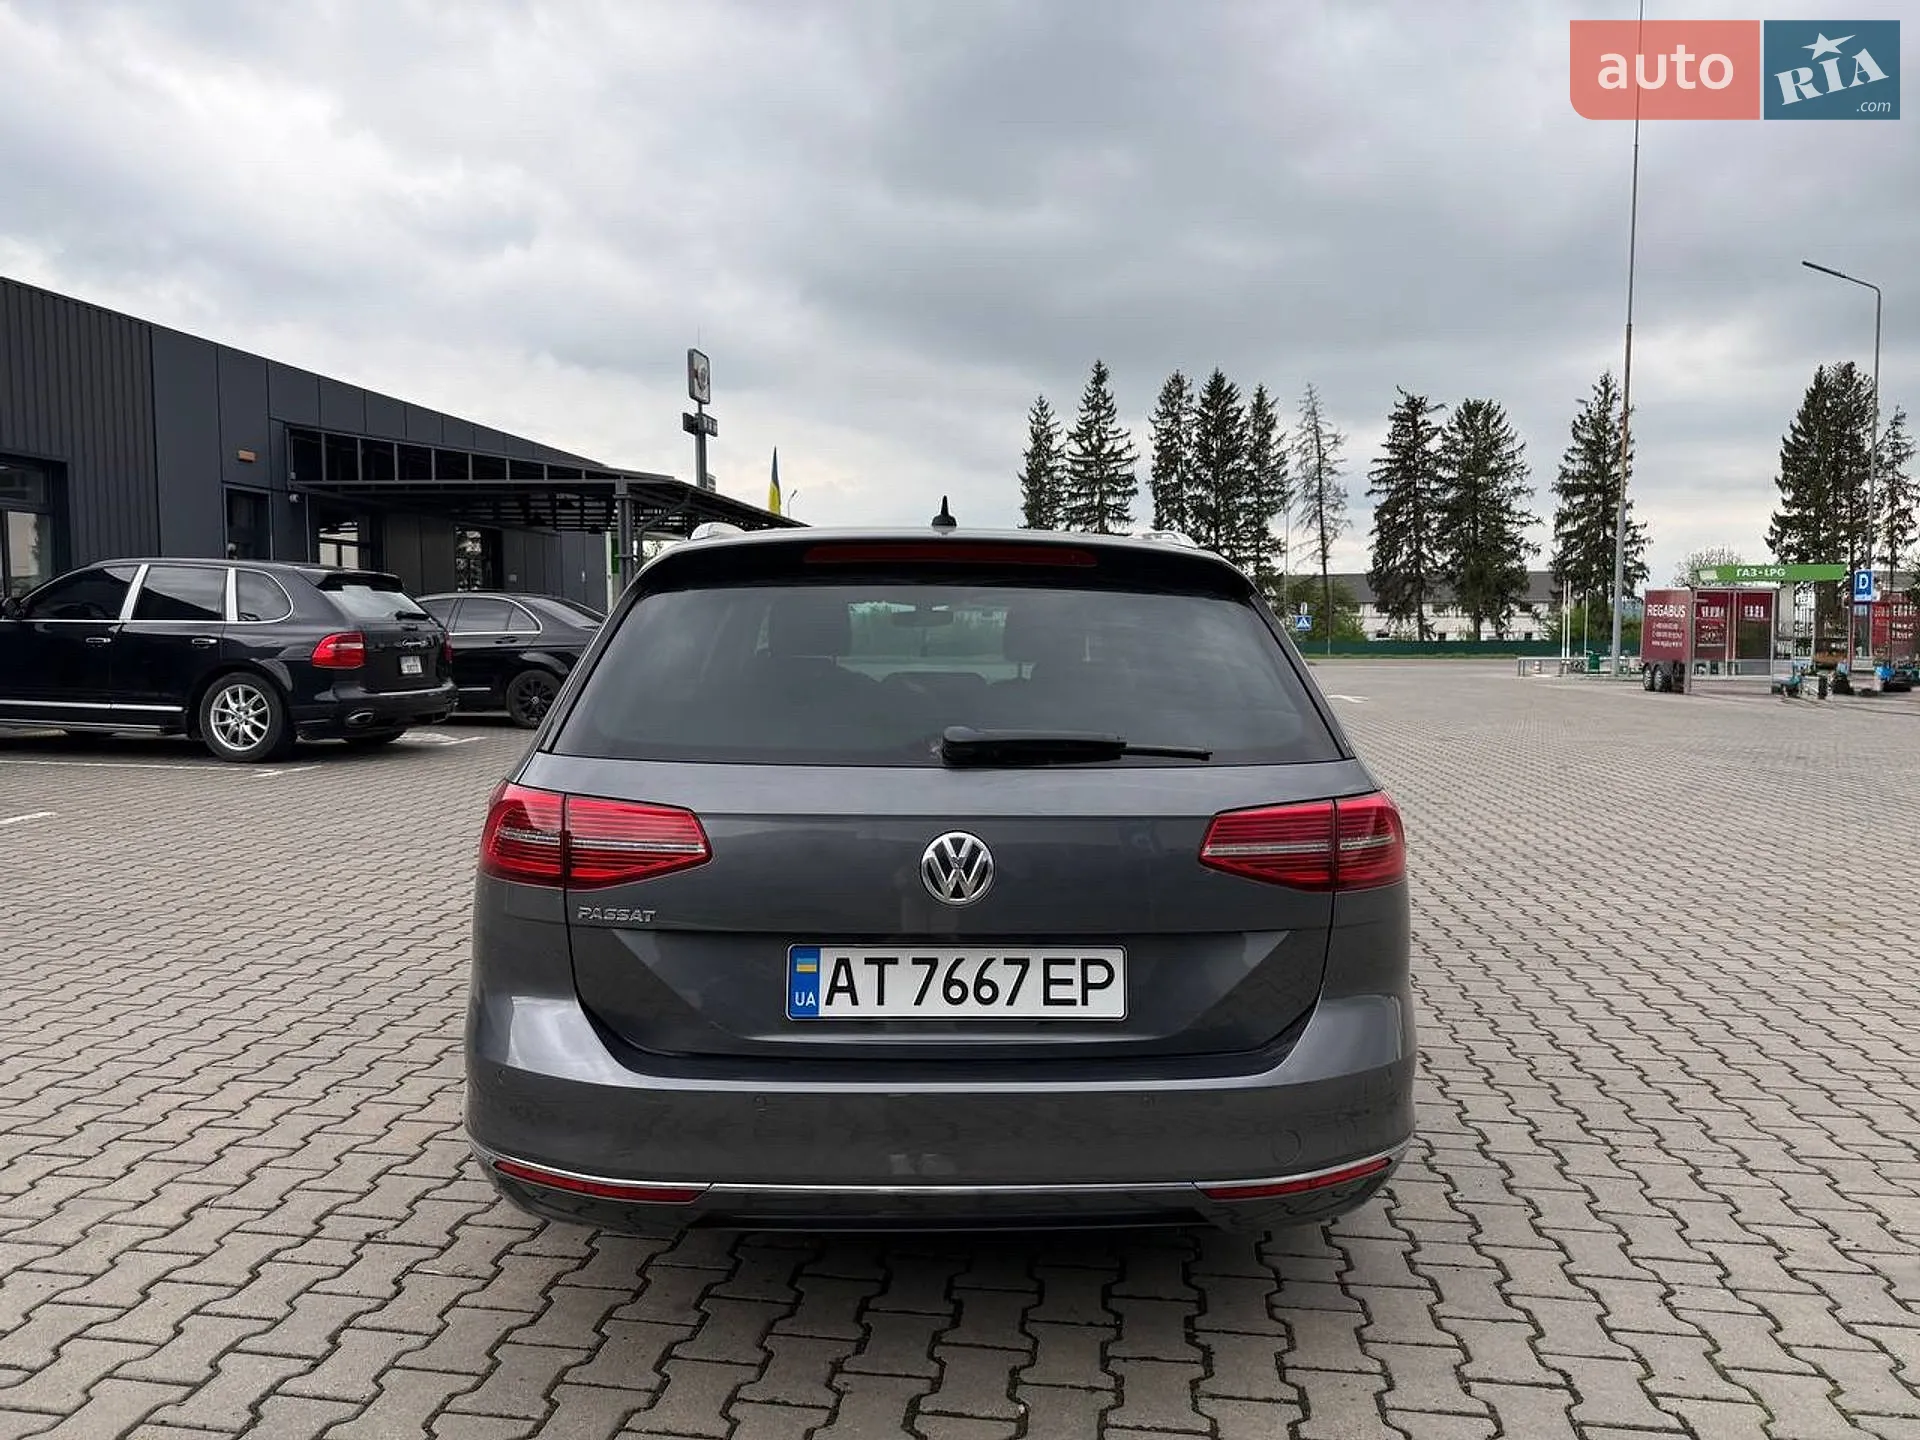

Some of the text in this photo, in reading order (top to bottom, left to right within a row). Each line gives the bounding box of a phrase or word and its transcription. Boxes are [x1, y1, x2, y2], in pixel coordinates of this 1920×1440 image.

[1646, 604, 1687, 618] REGABUS
[577, 905, 657, 923] PASSAT
[825, 957, 1116, 1007] AT 7667 EP
[795, 992, 816, 1007] UA
